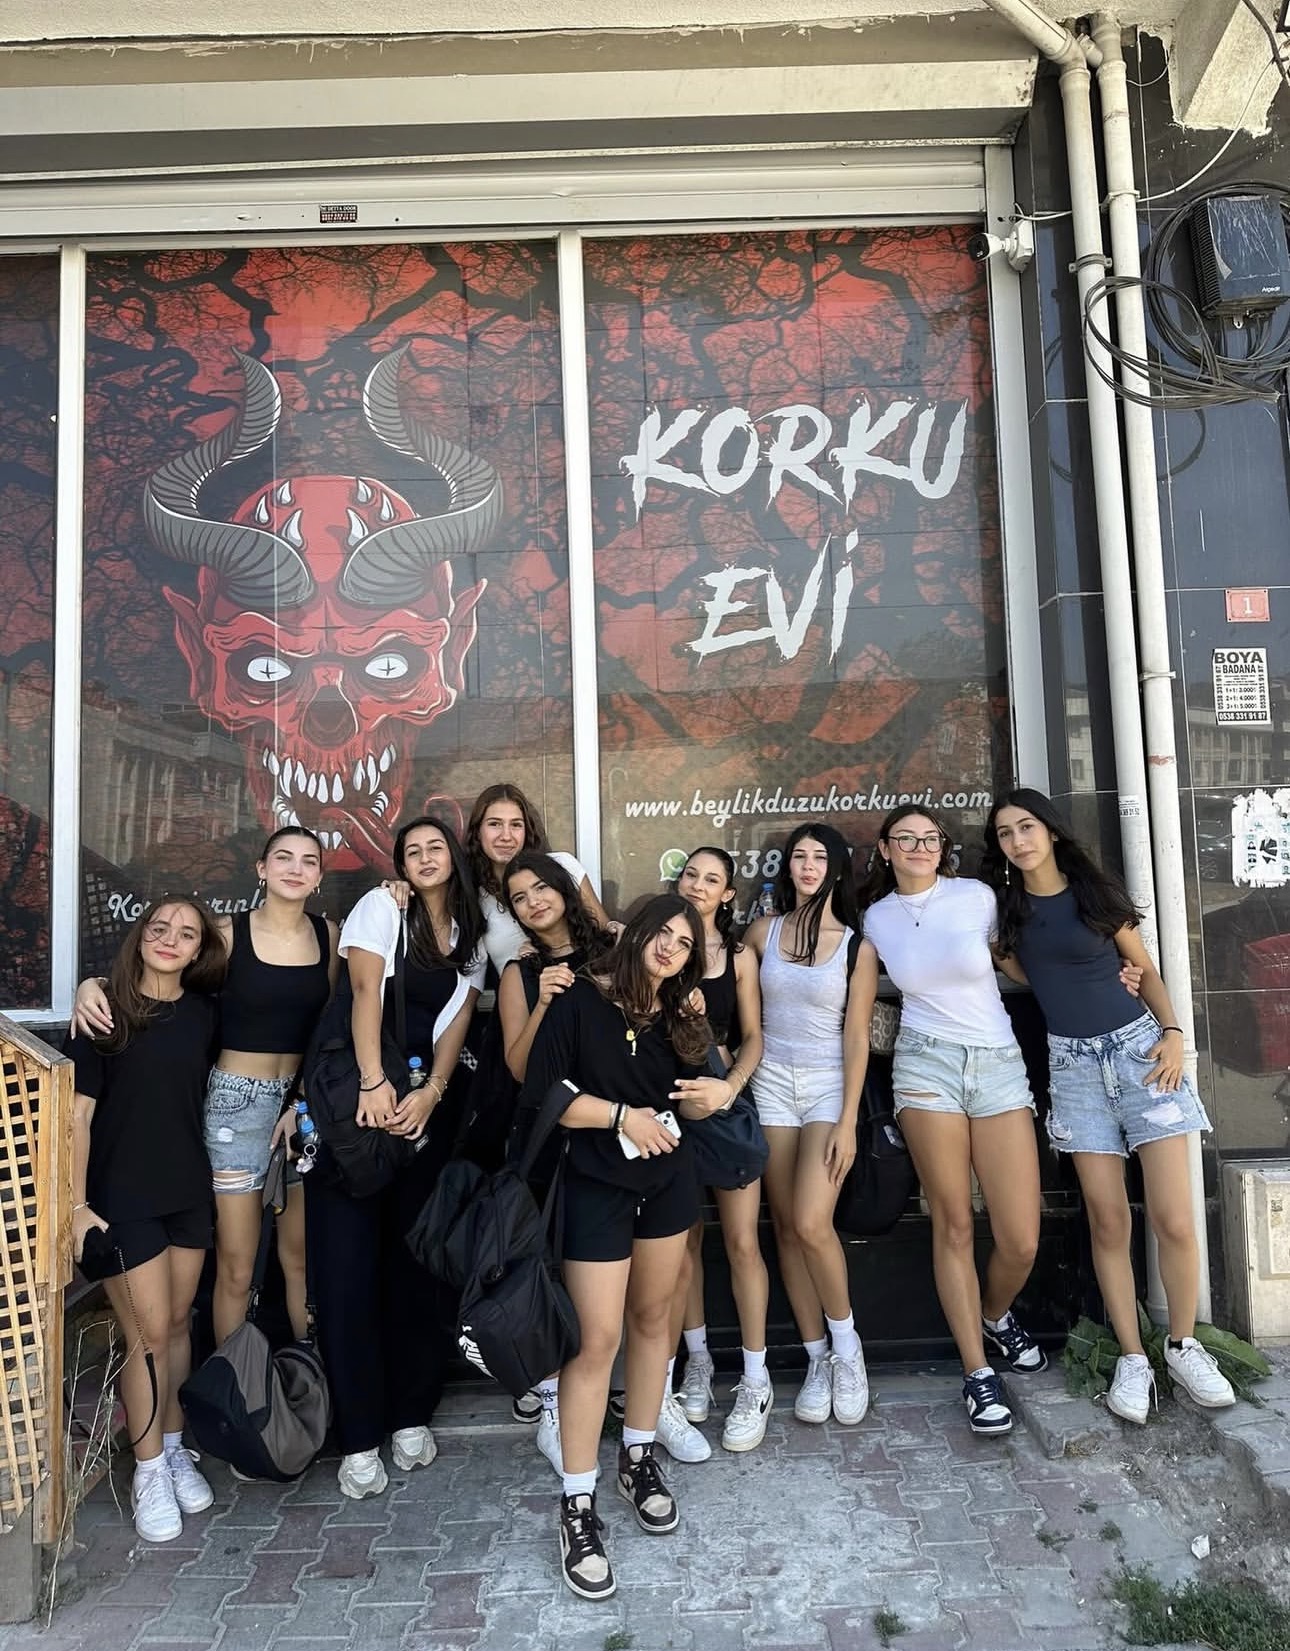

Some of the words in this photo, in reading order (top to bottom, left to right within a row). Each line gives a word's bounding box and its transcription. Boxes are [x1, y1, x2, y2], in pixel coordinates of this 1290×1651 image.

[619, 396, 968, 523] KORKU
[1242, 597, 1252, 614] 1
[1215, 651, 1264, 664] BOYA
[1222, 664, 1256, 674] BADANA
[625, 784, 993, 828] www.beylikduzukorkuevi.com
